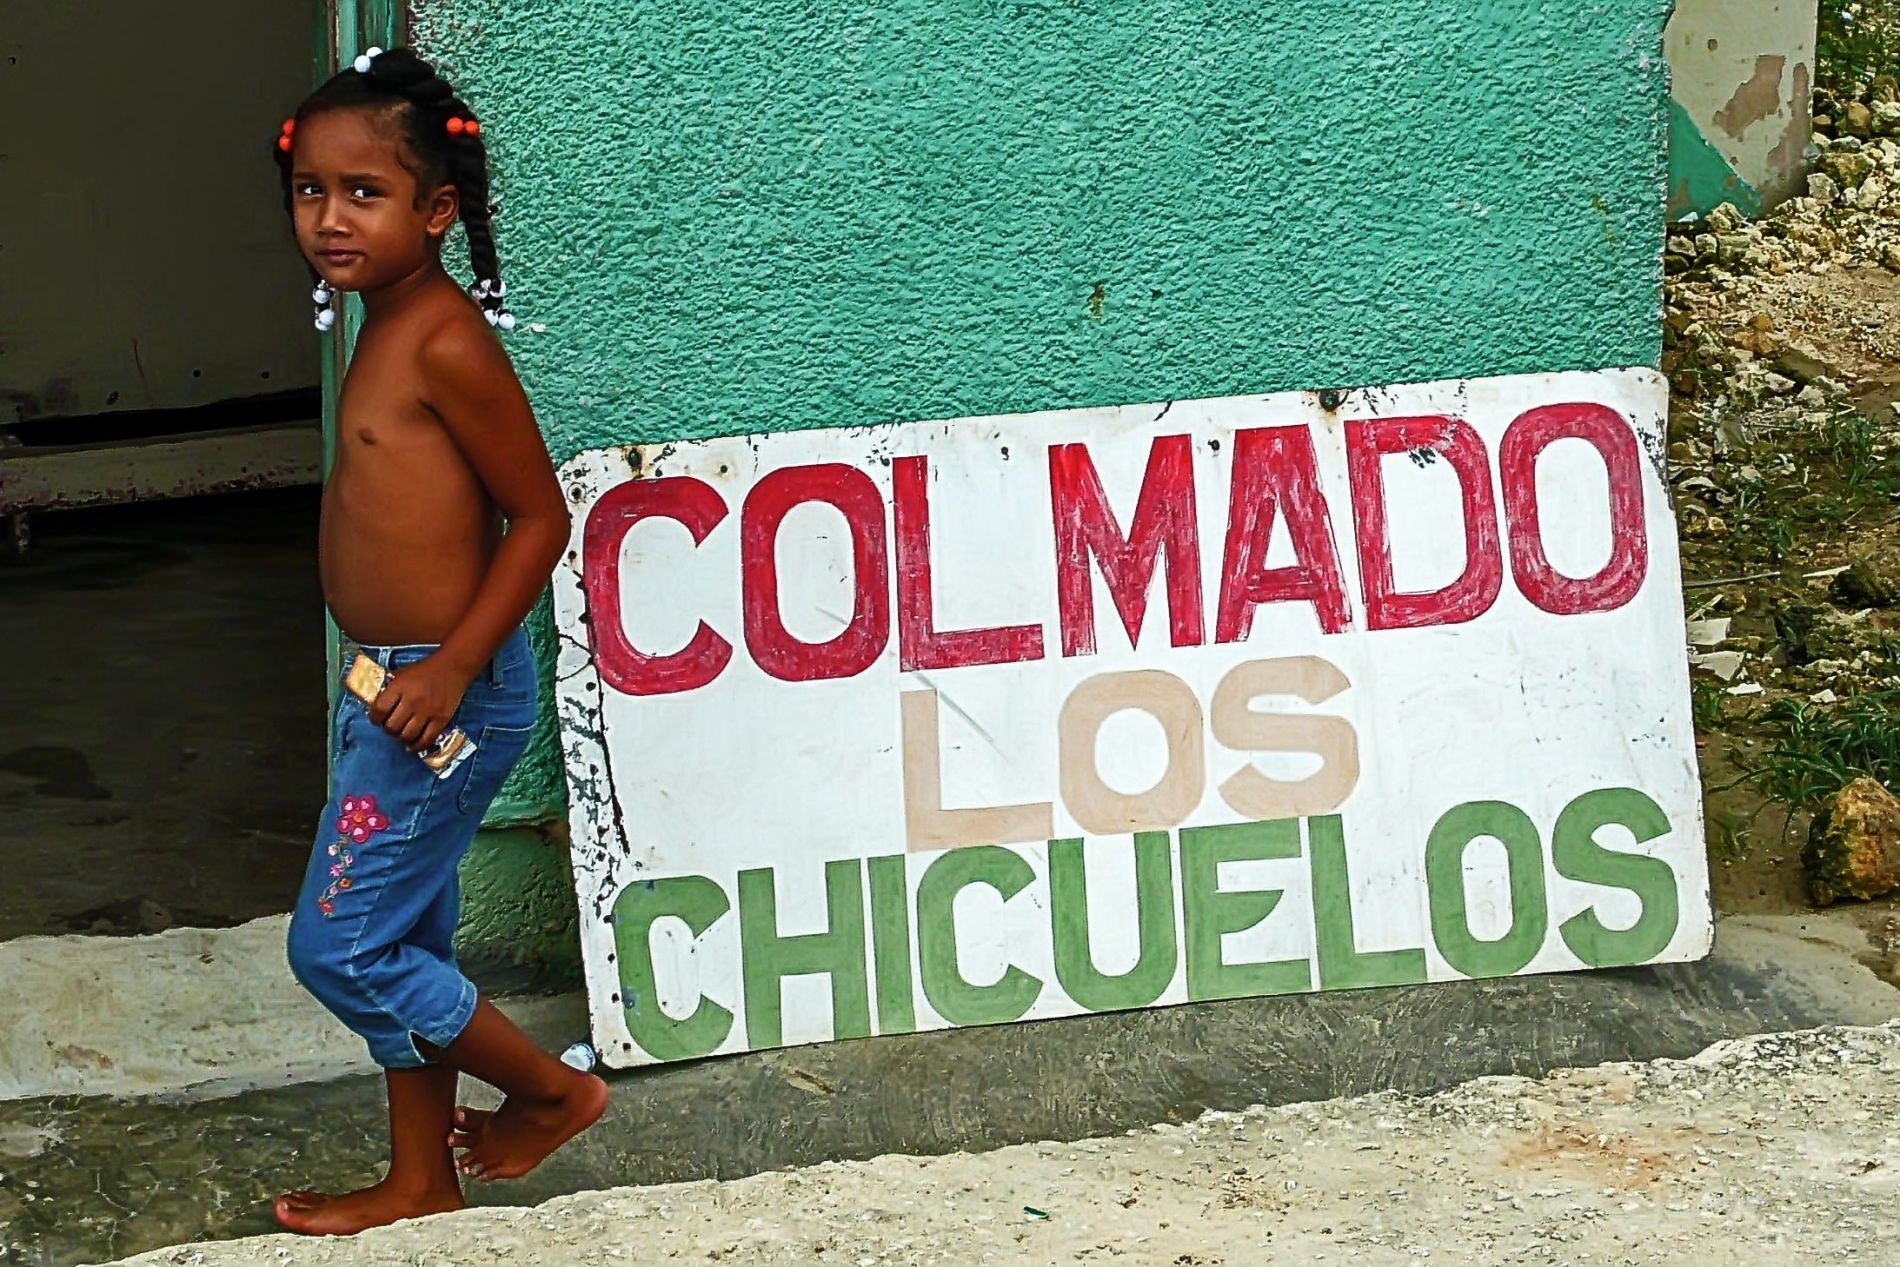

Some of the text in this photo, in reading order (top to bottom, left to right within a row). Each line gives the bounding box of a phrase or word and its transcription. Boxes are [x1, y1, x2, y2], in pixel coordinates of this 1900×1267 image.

[583, 401, 1649, 696] COLMADO
[900, 655, 1360, 852] LOS
[615, 787, 1680, 1062] CHICUELOS
